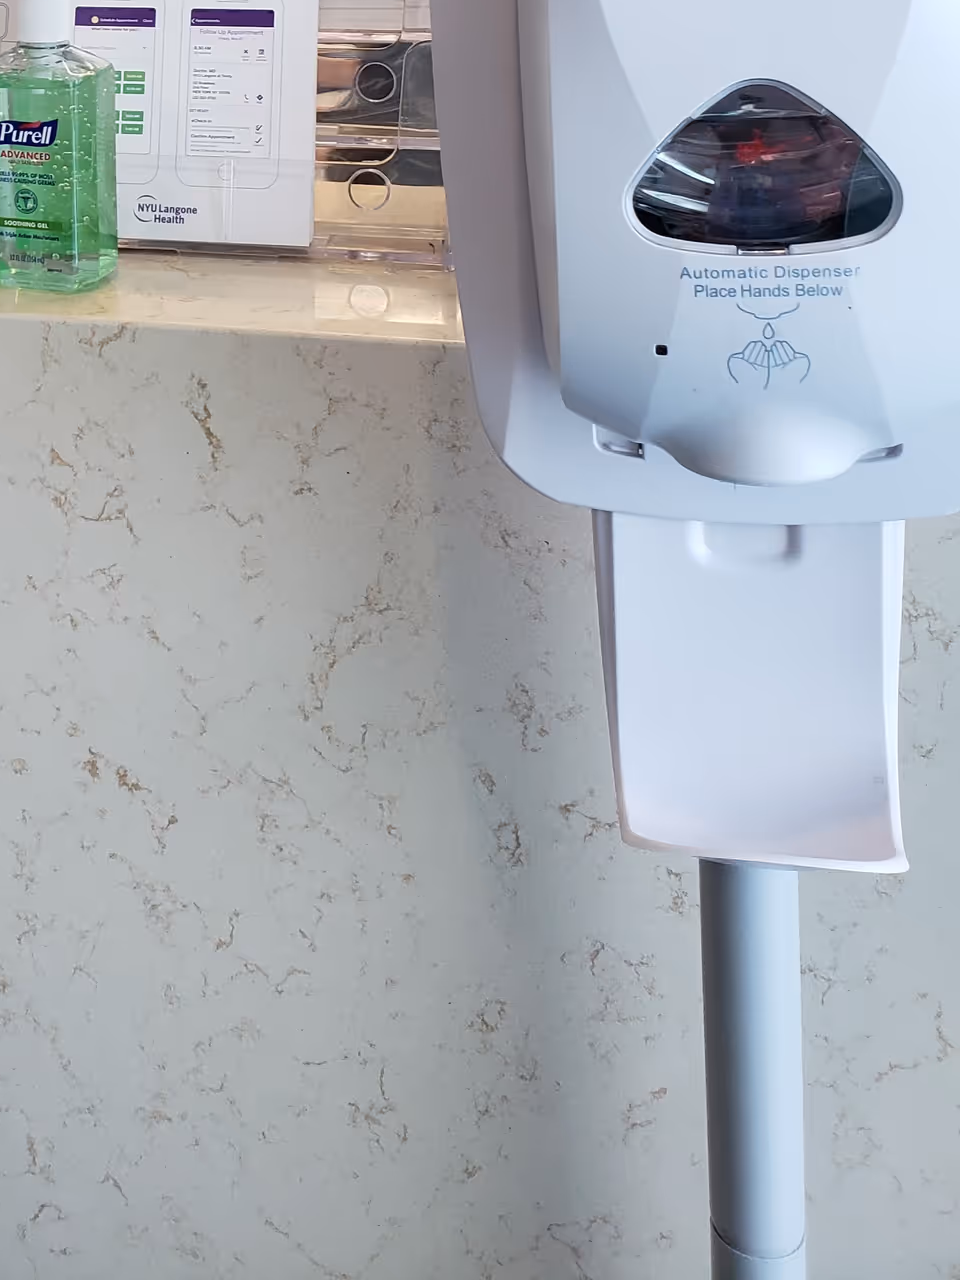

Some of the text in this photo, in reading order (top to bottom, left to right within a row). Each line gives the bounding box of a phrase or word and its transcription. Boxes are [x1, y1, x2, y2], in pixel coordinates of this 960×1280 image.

[0, 123, 52, 144] Purell
[0, 150, 51, 160] ADVANCED
[138, 203, 198, 215] NYU Langone
[4, 220, 36, 228] SOOTHING
[154, 214, 185, 224] Health
[680, 265, 860, 281] Automatic Dispenser
[694, 283, 843, 298] Place Hands Below
